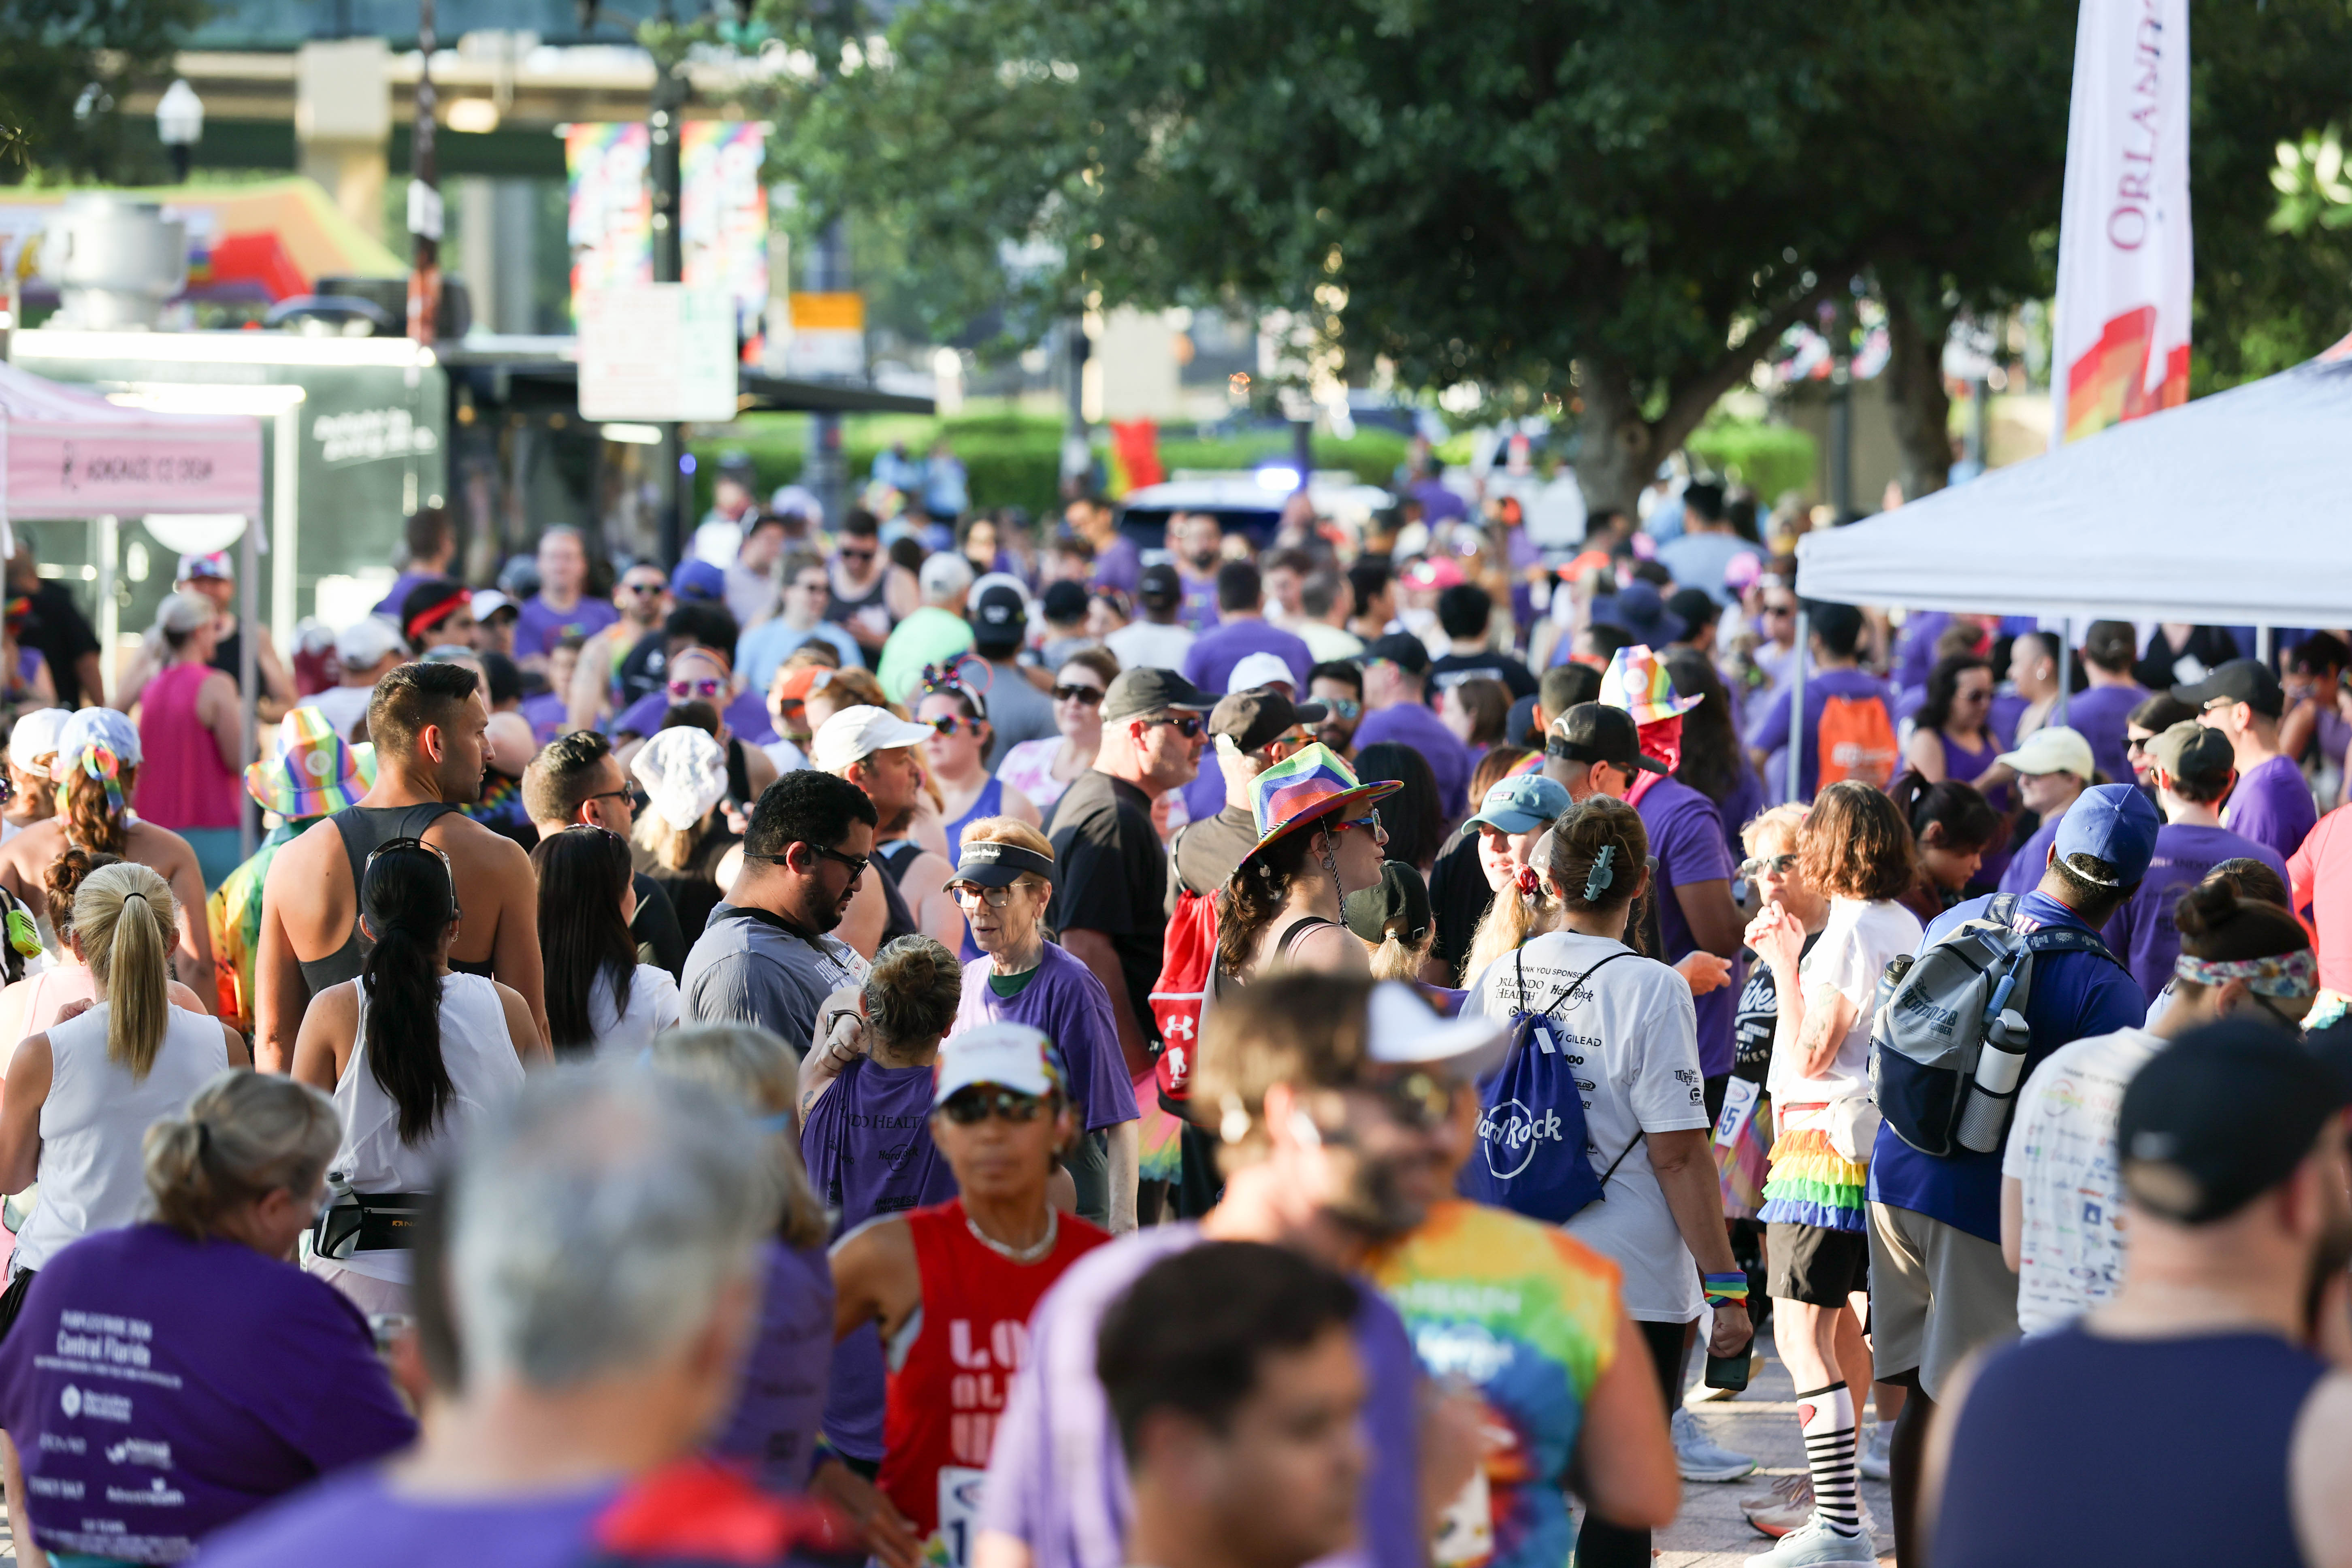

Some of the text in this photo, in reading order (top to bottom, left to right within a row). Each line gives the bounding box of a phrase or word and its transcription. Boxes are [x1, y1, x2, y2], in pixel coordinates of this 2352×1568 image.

[1552, 969, 1592, 980] SPONSOS
[1572, 988, 1594, 1002] Rock
[1566, 1034, 1602, 1047] GILEAD
[1674, 1069, 1693, 1086] UCF
[1505, 1108, 1563, 1149] Rock
[875, 1195, 918, 1206] IMPRESS
[876, 1205, 894, 1214] INK
[57, 1329, 103, 1359] Central
[104, 1335, 151, 1368] Florida
